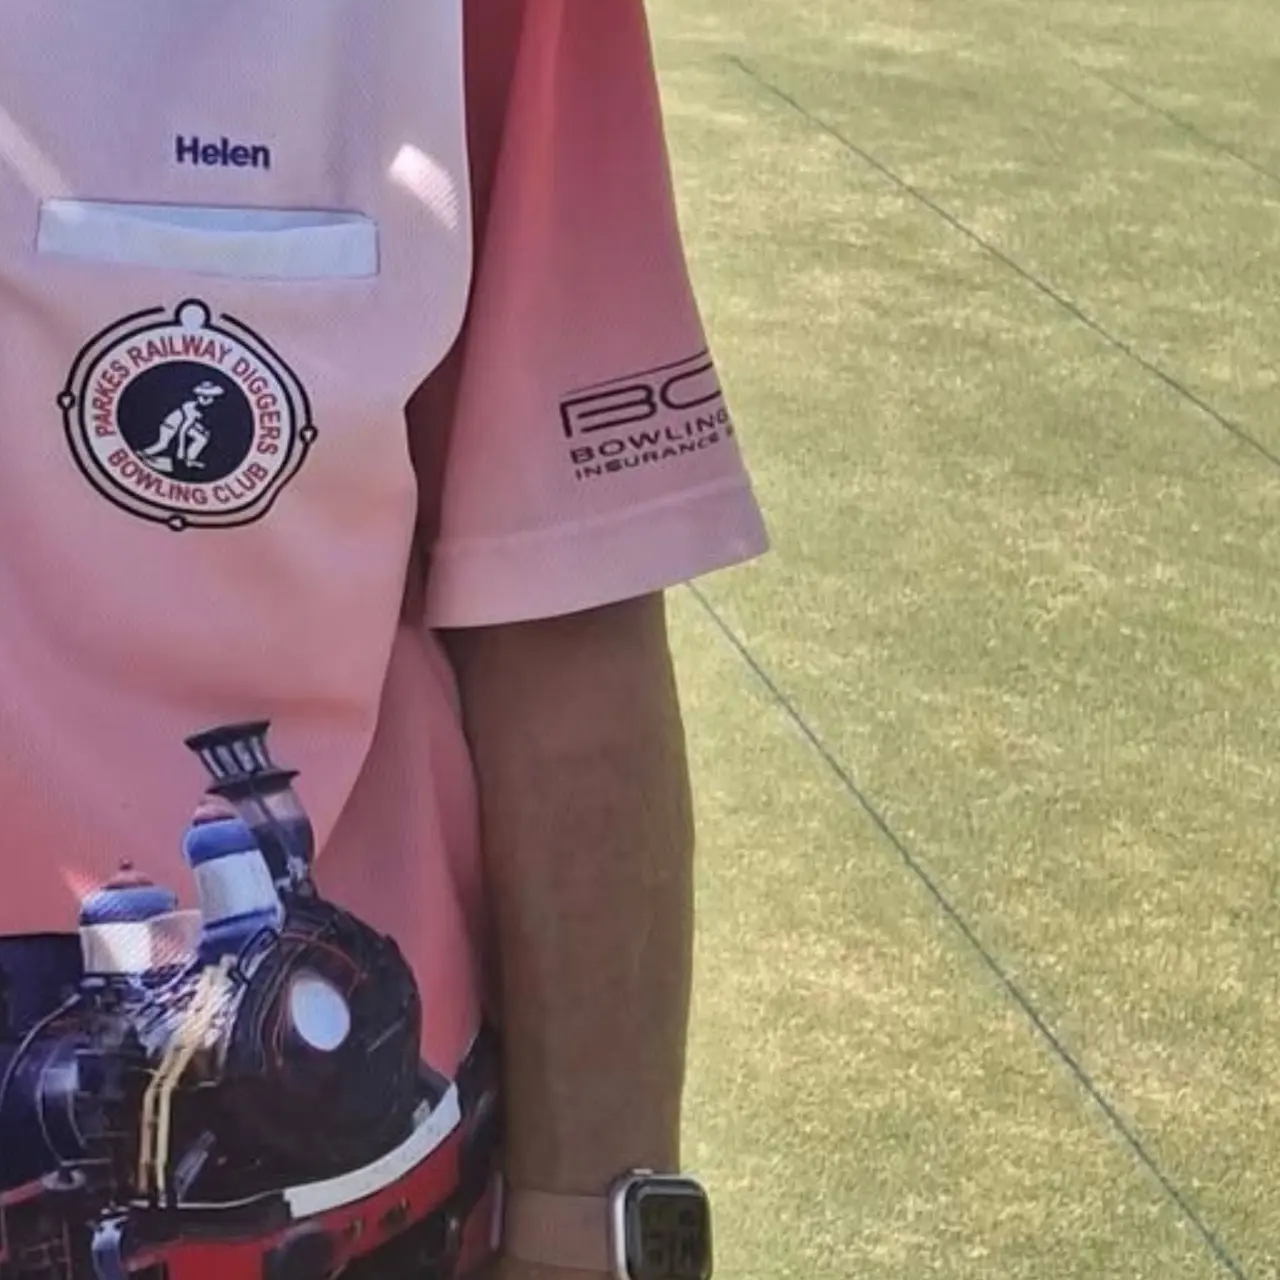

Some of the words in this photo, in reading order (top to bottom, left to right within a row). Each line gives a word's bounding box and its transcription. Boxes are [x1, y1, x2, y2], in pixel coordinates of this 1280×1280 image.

[176, 134, 271, 169] Helen
[92, 360, 131, 438] PARKES
[127, 334, 233, 368] RAILWAY
[231, 357, 282, 456] DIGGERS
[569, 408, 730, 465] BOWLING
[574, 430, 721, 481] INSURANCE
[107, 447, 209, 506] BOWLING
[212, 461, 269, 504] CLUB
